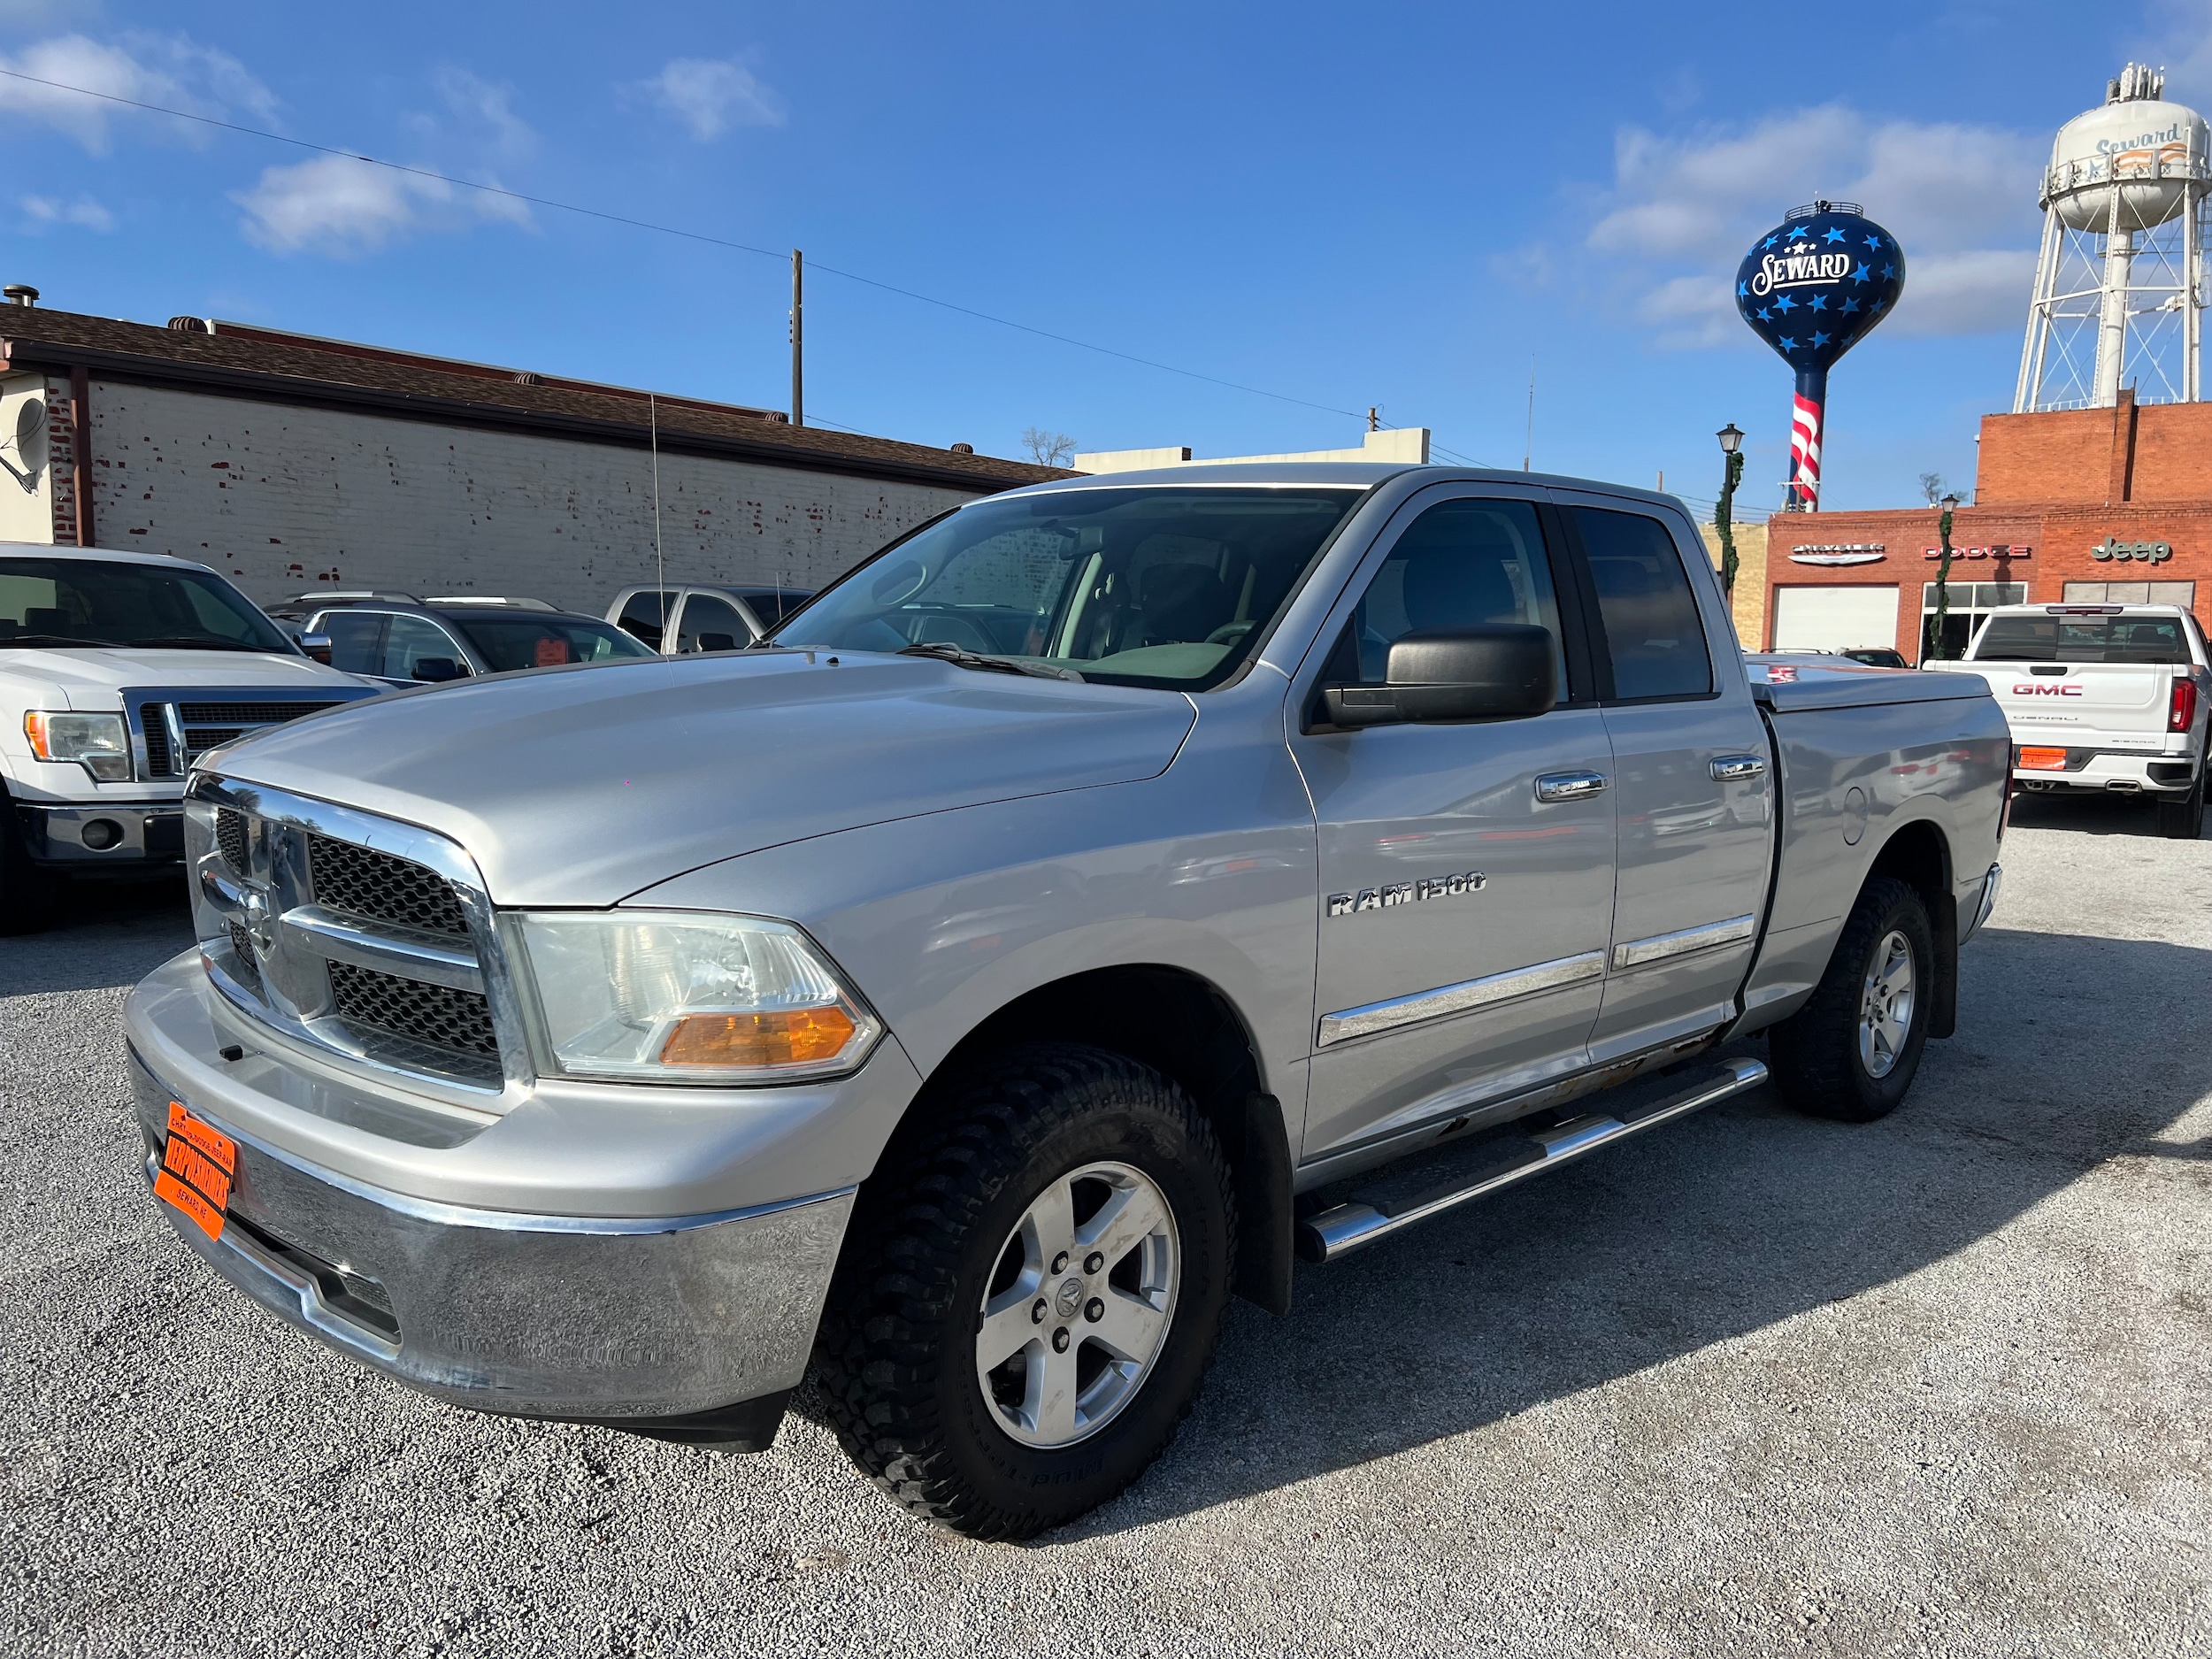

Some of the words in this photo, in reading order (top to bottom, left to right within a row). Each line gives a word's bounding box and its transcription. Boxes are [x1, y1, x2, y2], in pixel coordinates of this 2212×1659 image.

[2095, 123, 2182, 154] Seward
[1752, 254, 1850, 296] SEWARD
[1921, 544, 2029, 558] DODGE
[2091, 535, 2170, 563] Jeep
[2012, 684, 2083, 696] GMC
[1327, 881, 1412, 917] RAM
[1417, 871, 1487, 901] 1500
